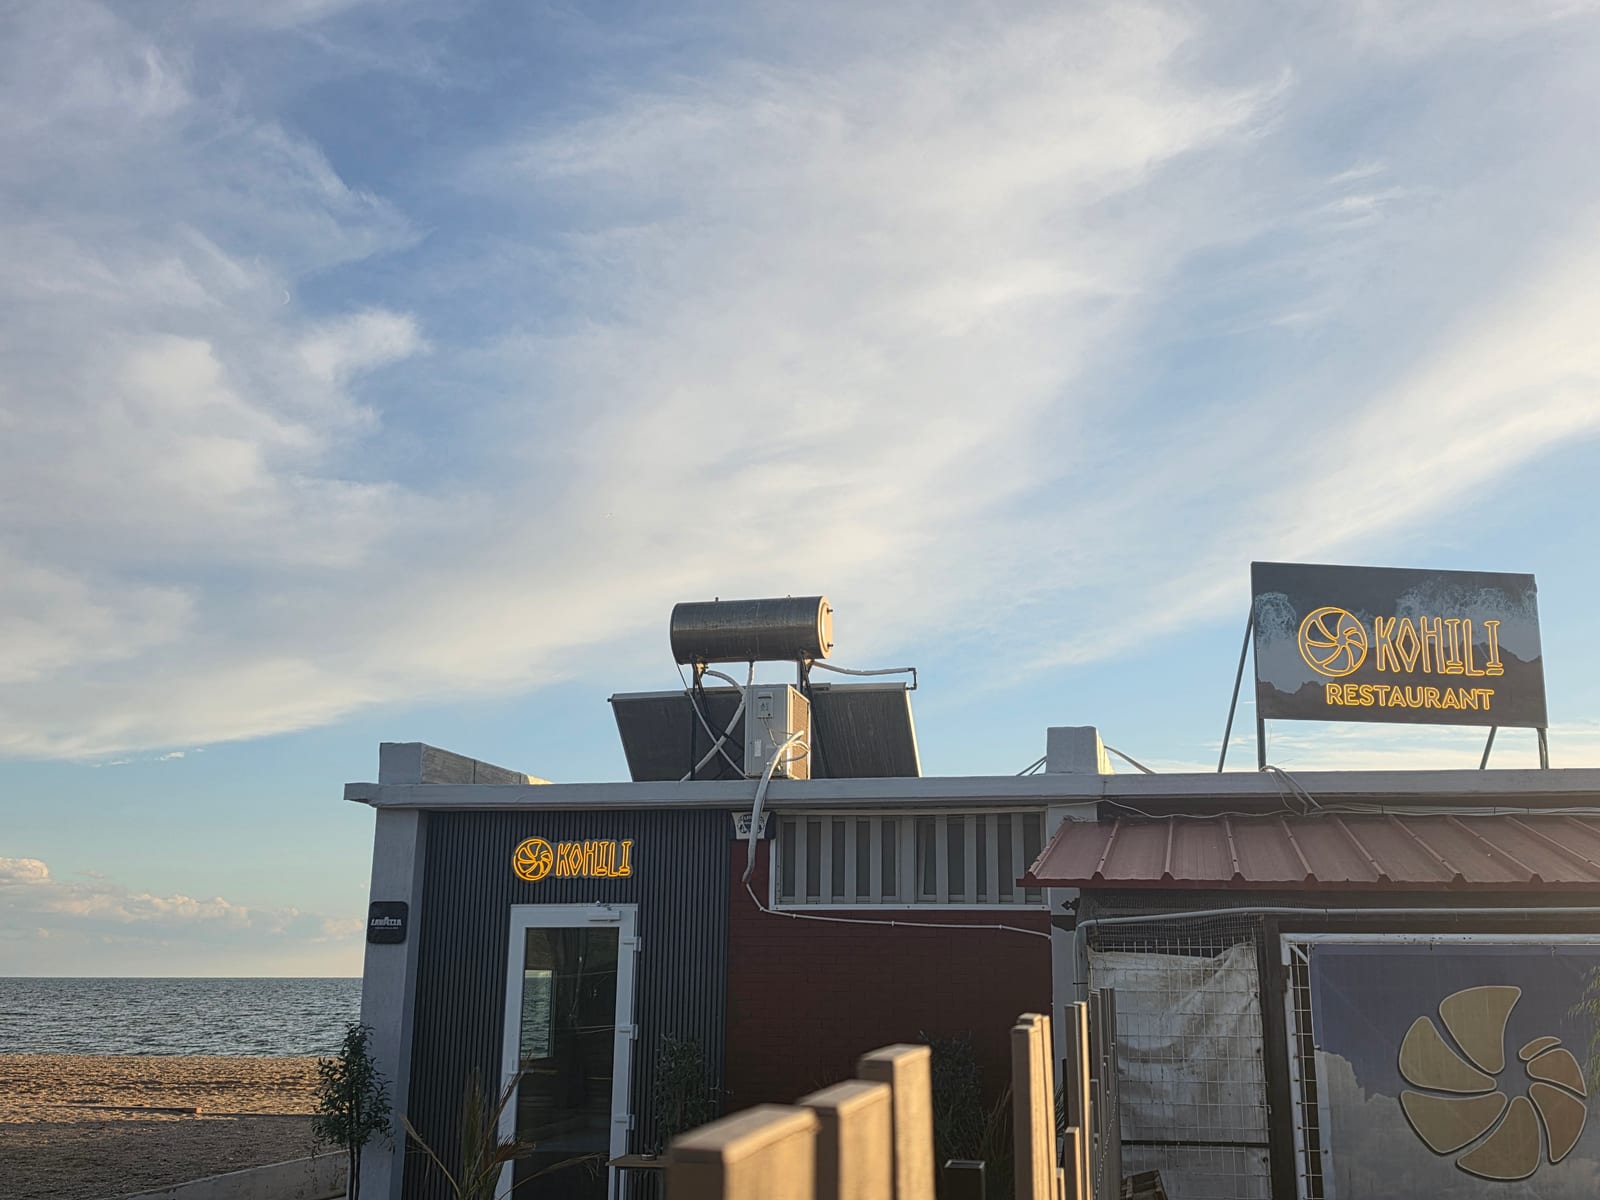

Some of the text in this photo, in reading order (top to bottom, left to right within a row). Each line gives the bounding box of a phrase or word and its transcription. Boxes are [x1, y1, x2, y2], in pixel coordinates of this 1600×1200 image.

[1375, 615, 1504, 677] KOHILI
[1325, 683, 1495, 711] RESTAURANT
[555, 840, 632, 877] KOHILI
